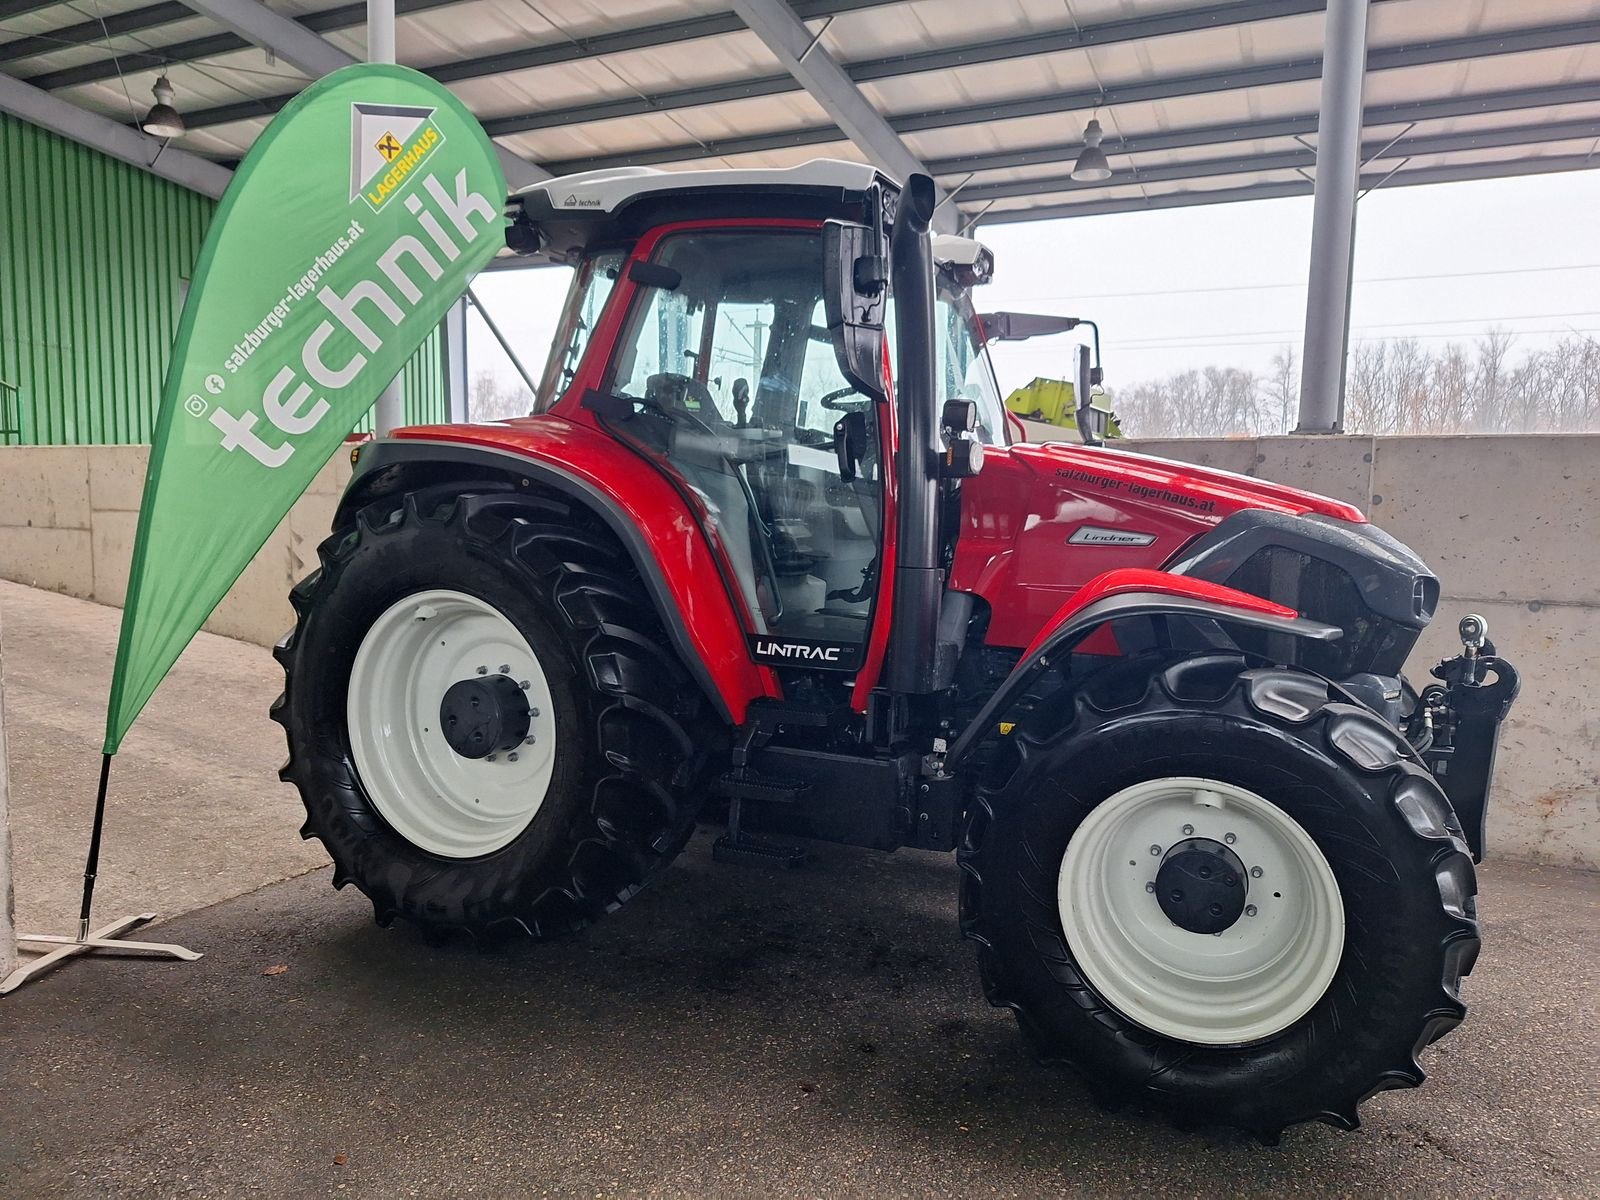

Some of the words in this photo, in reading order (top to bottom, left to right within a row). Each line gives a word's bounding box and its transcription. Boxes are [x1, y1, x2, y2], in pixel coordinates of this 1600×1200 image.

[367, 128, 438, 206] LAGERHAUS
[578, 199, 601, 207] technik
[208, 167, 497, 468] technik
[223, 219, 365, 374] salzburger-lagerhaus.at
[1055, 467, 1216, 513] salzburger-lagerhaus.at
[1083, 532, 1141, 543] Lindner
[756, 642, 840, 660] LINTRAC
